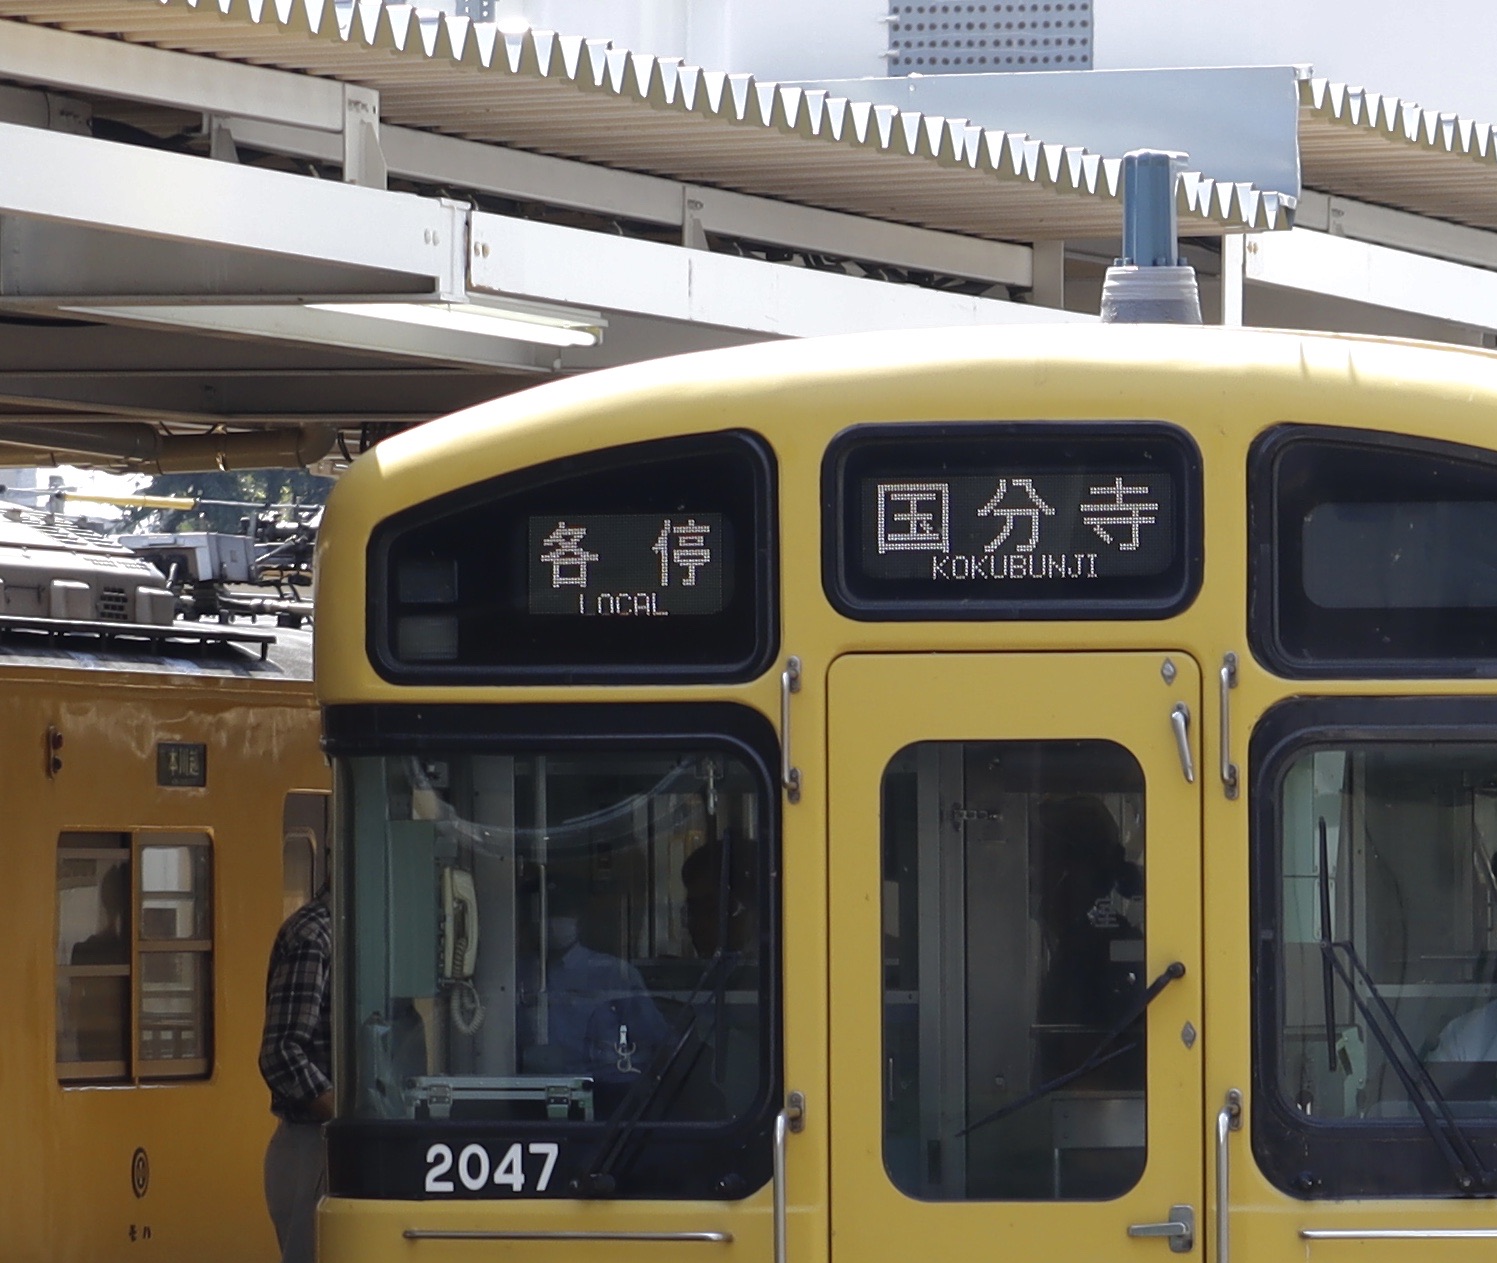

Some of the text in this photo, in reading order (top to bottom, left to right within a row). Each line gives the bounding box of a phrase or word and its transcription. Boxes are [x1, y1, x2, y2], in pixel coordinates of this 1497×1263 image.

[877, 477, 1159, 554] 国分寺
[541, 519, 710, 588] 各停
[932, 553, 1098, 580] KOKUBUNJI
[579, 592, 669, 616] LOCAL
[425, 1143, 559, 1192] 2047
